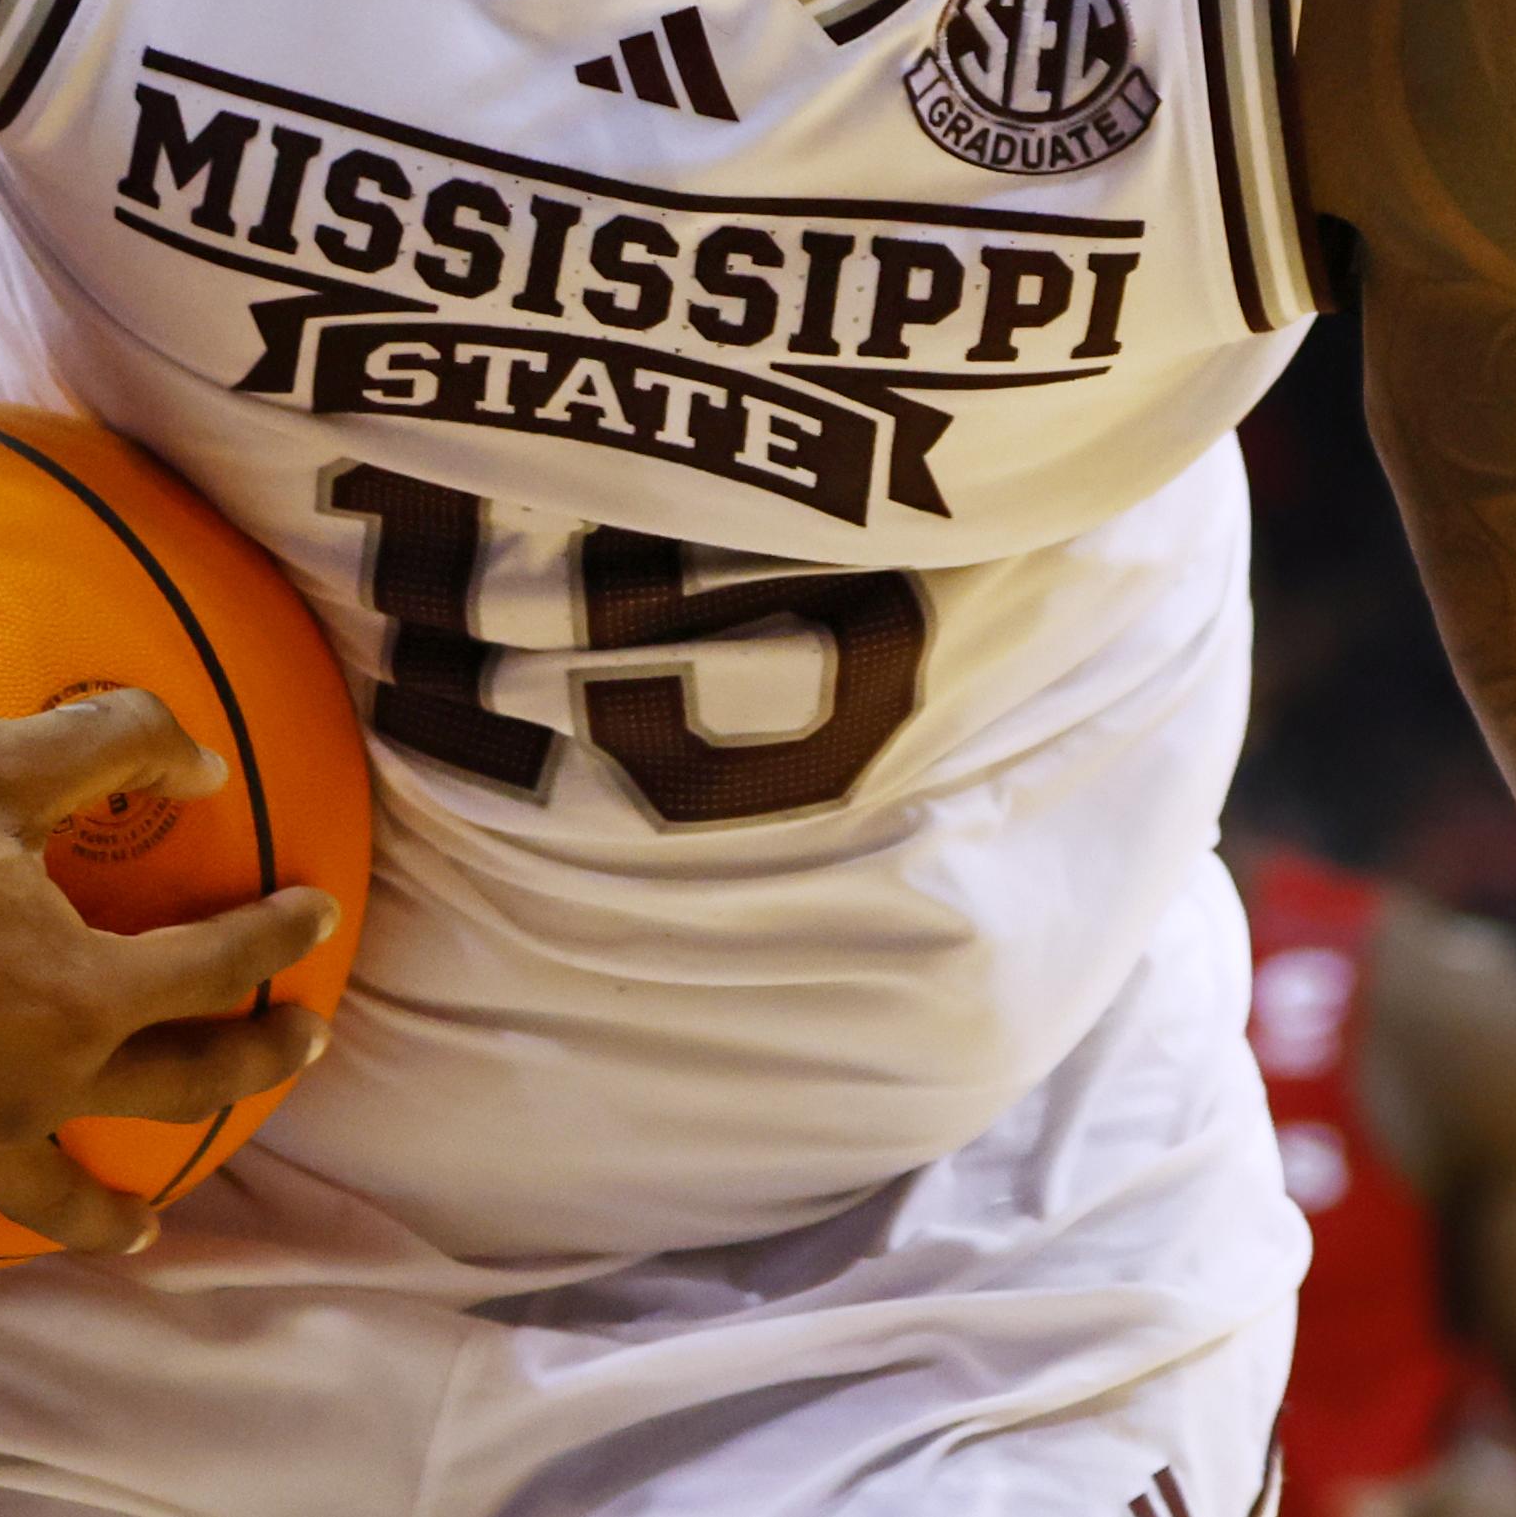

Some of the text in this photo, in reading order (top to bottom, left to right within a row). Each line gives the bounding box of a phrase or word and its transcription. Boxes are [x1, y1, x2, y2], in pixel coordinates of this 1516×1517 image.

[118, 83, 1141, 362] MISSISSIPPI
[928, 95, 1126, 169] GRADUATE
[362, 342, 822, 488] STATE
[316, 457, 938, 834] 15
